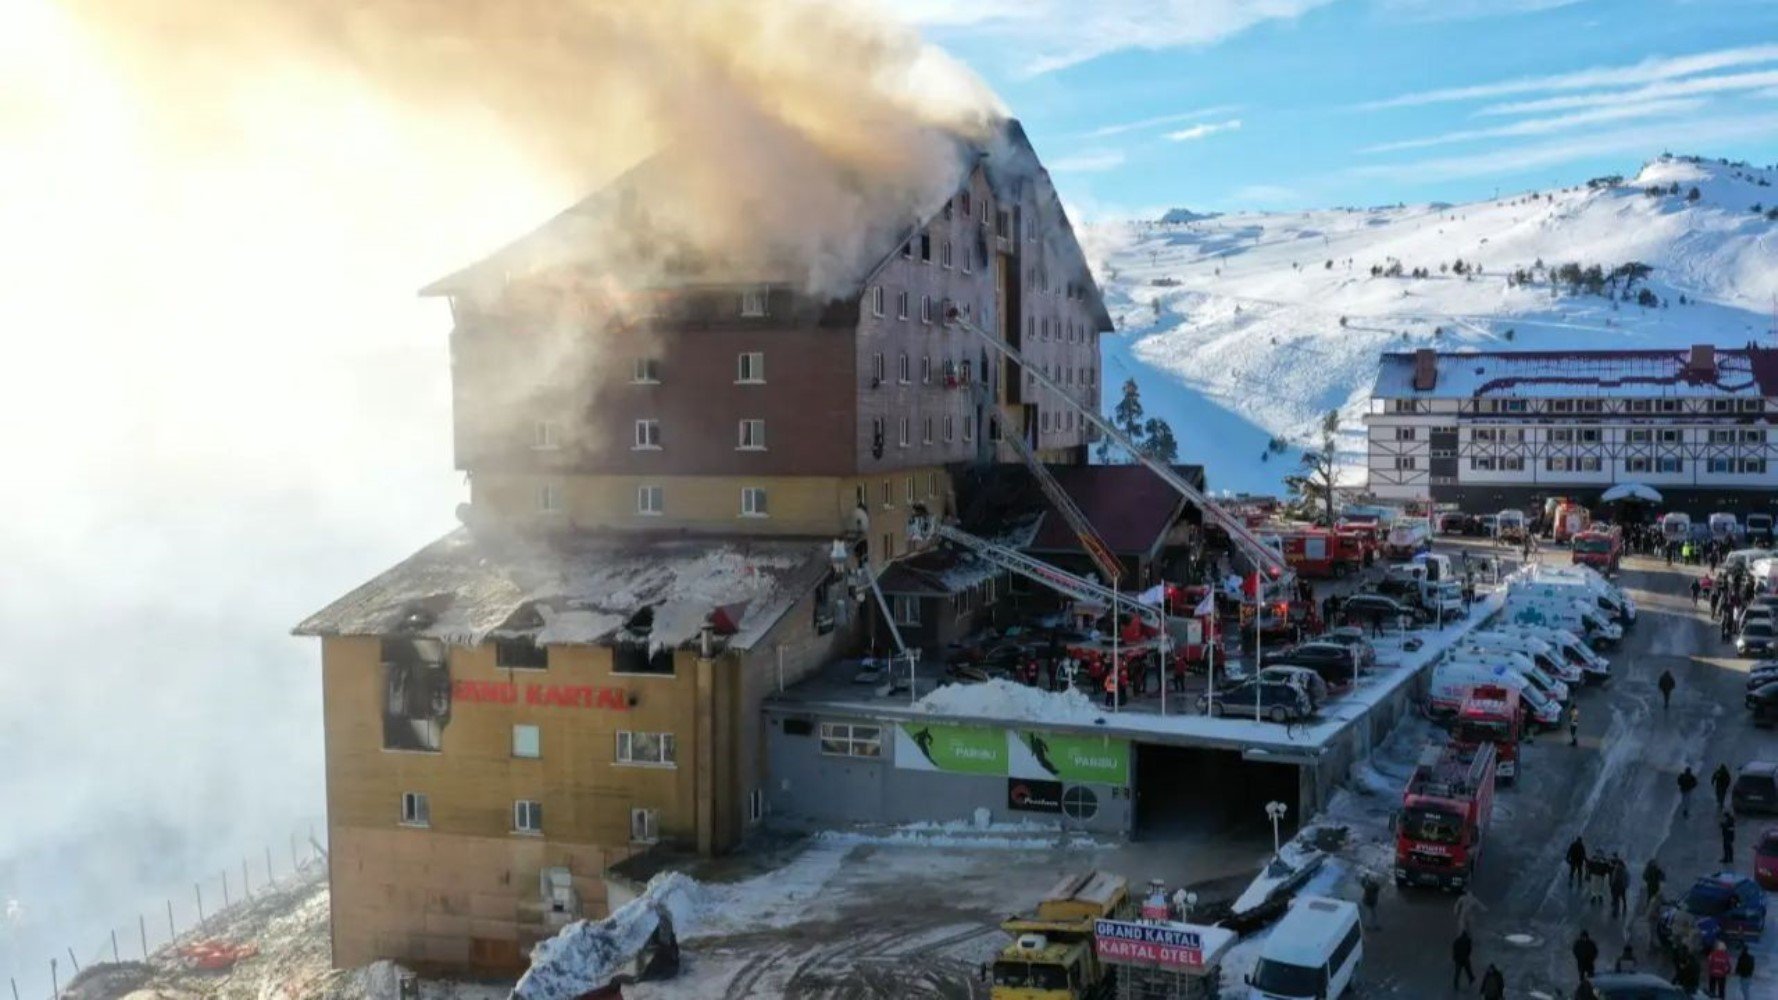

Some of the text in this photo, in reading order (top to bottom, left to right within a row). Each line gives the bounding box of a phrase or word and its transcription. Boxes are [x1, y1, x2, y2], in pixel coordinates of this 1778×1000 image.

[1098, 923, 1199, 947] GRAND KARTAL
[1099, 940, 1199, 964] KARTAL OTEL
